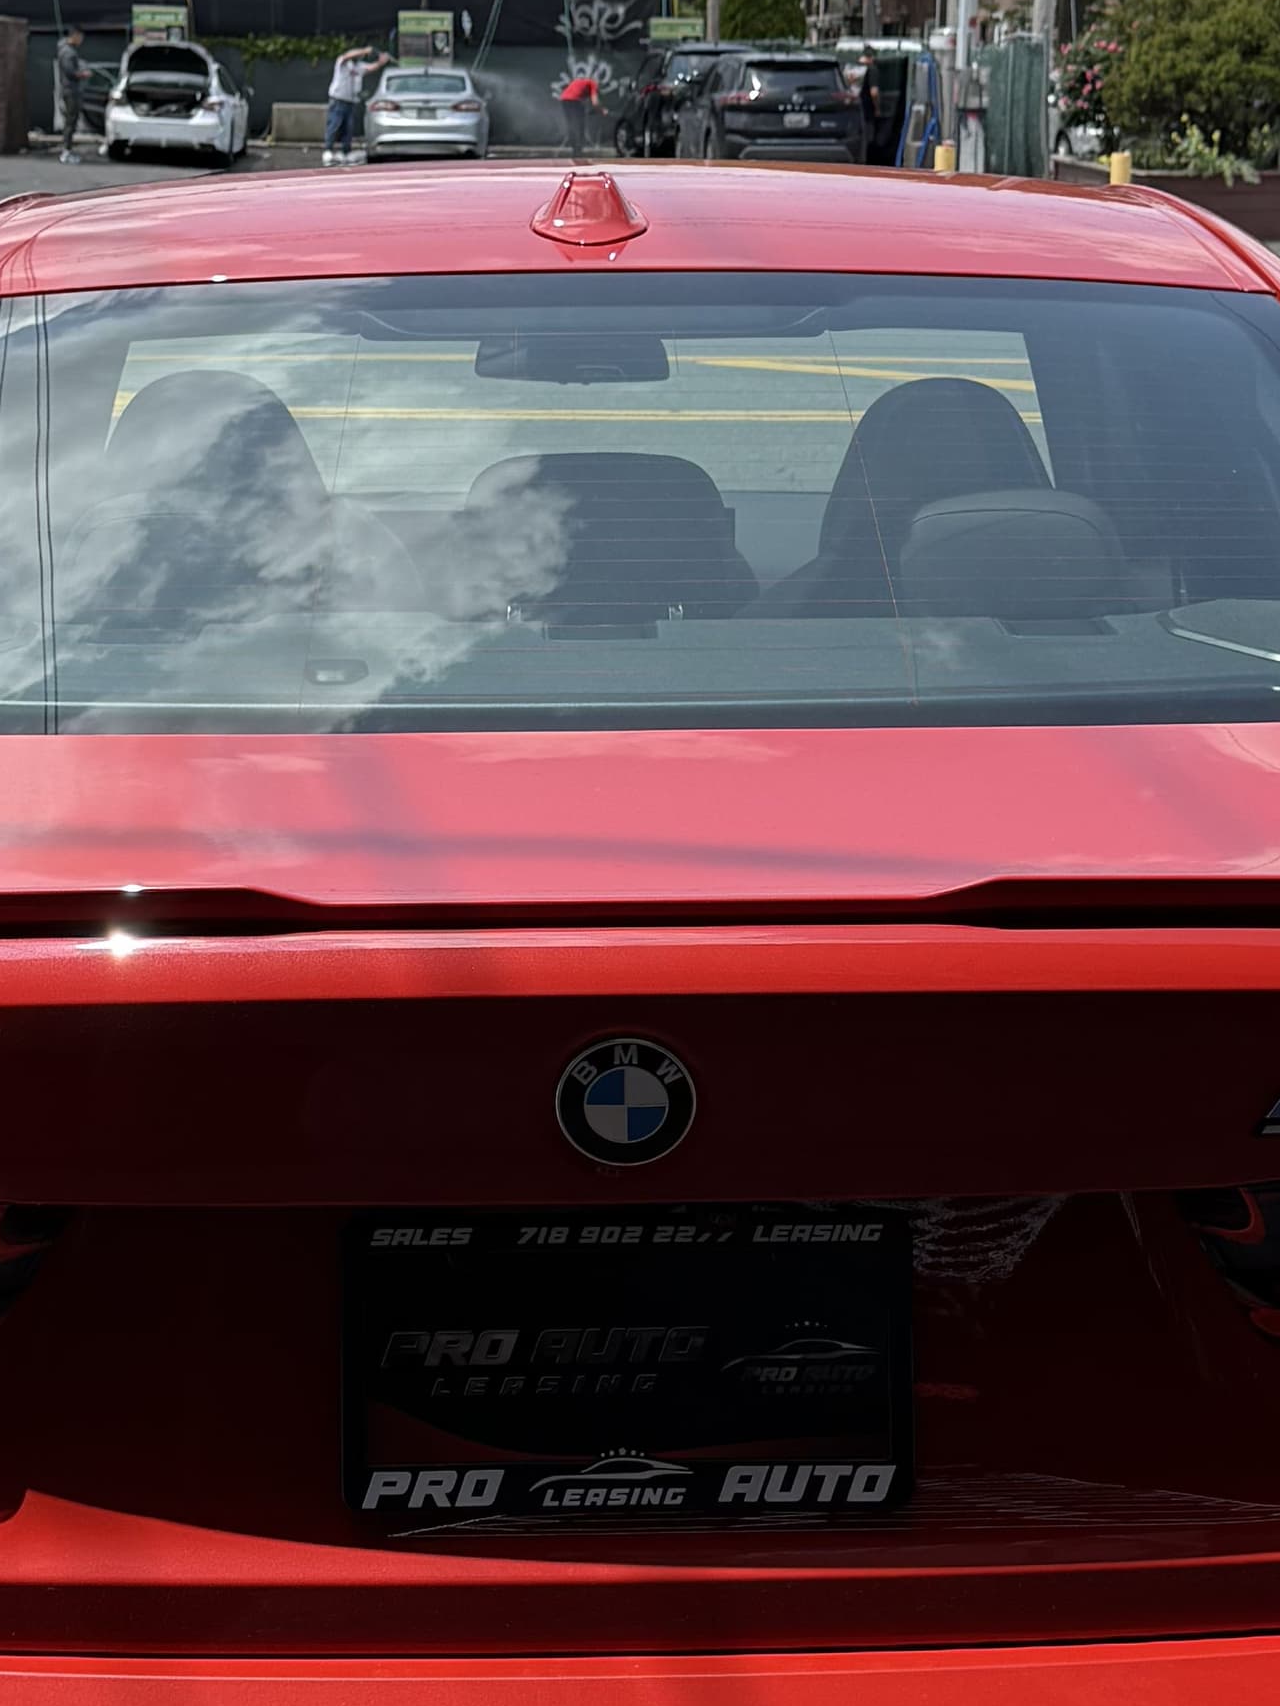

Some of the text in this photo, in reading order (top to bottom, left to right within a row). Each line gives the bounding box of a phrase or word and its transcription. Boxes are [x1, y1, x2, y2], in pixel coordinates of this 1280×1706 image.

[570, 1044, 685, 1086] BMW
[370, 1227, 473, 1247] SALES
[516, 1226, 569, 1246] 718
[577, 1225, 644, 1245] 902
[751, 1223, 884, 1244] LEASING
[379, 1325, 711, 1368] PRO AUTO
[431, 1372, 662, 1397] LEASING
[361, 1464, 897, 1510] PRO LEASING AUTO
